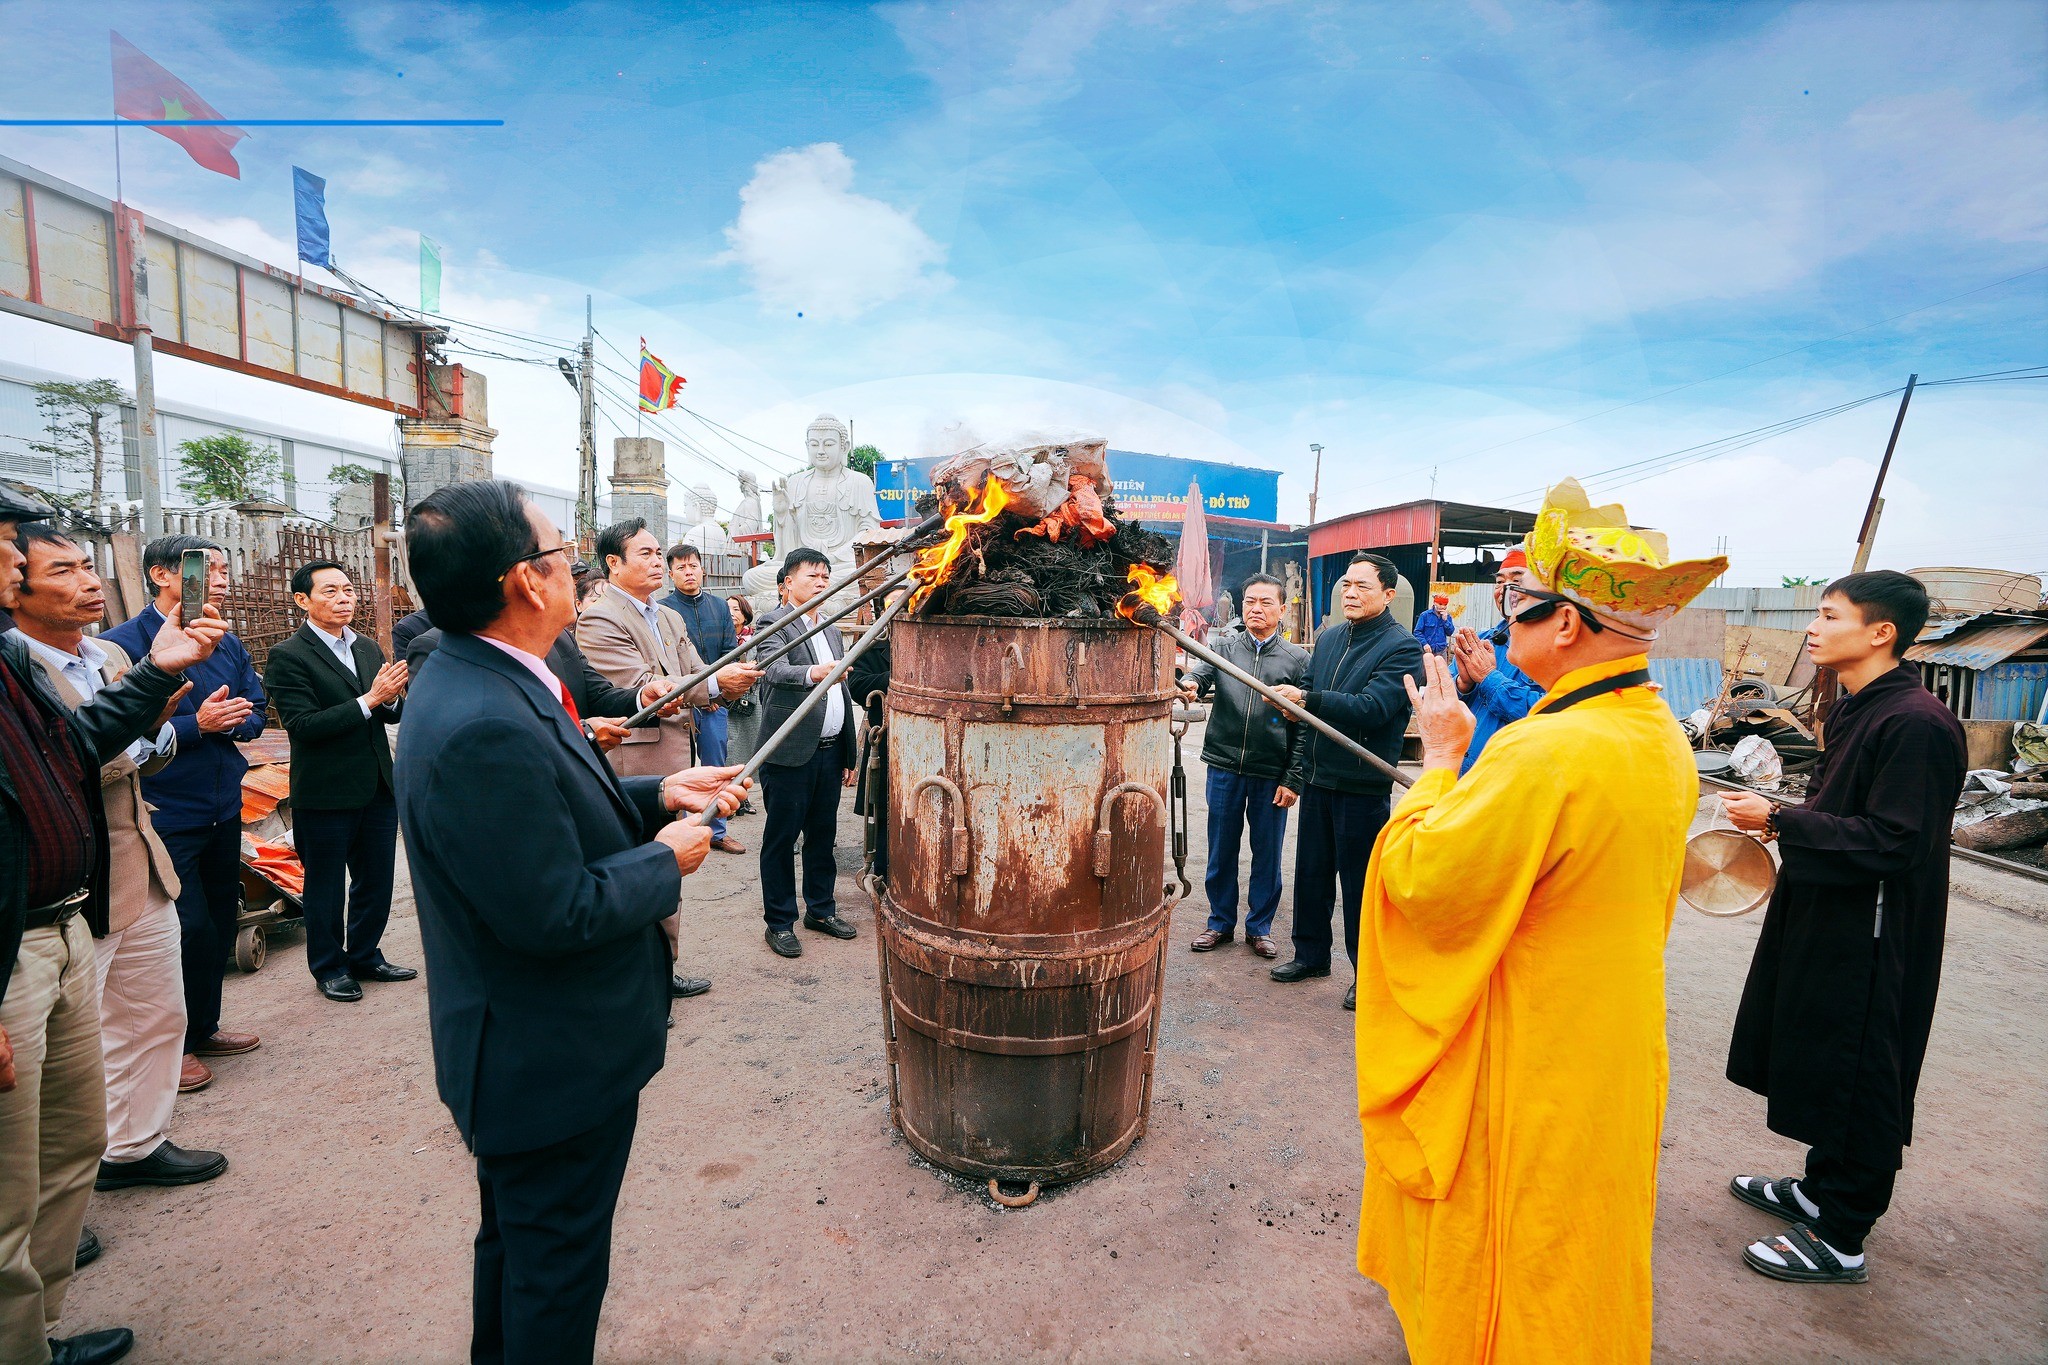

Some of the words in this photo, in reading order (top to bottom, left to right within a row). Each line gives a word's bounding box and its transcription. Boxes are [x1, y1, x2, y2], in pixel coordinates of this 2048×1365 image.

[1112, 479, 1145, 491] HIÊN
[1209, 492, 1226, 508] ĐỒ
[1227, 494, 1250, 509] THỜ
